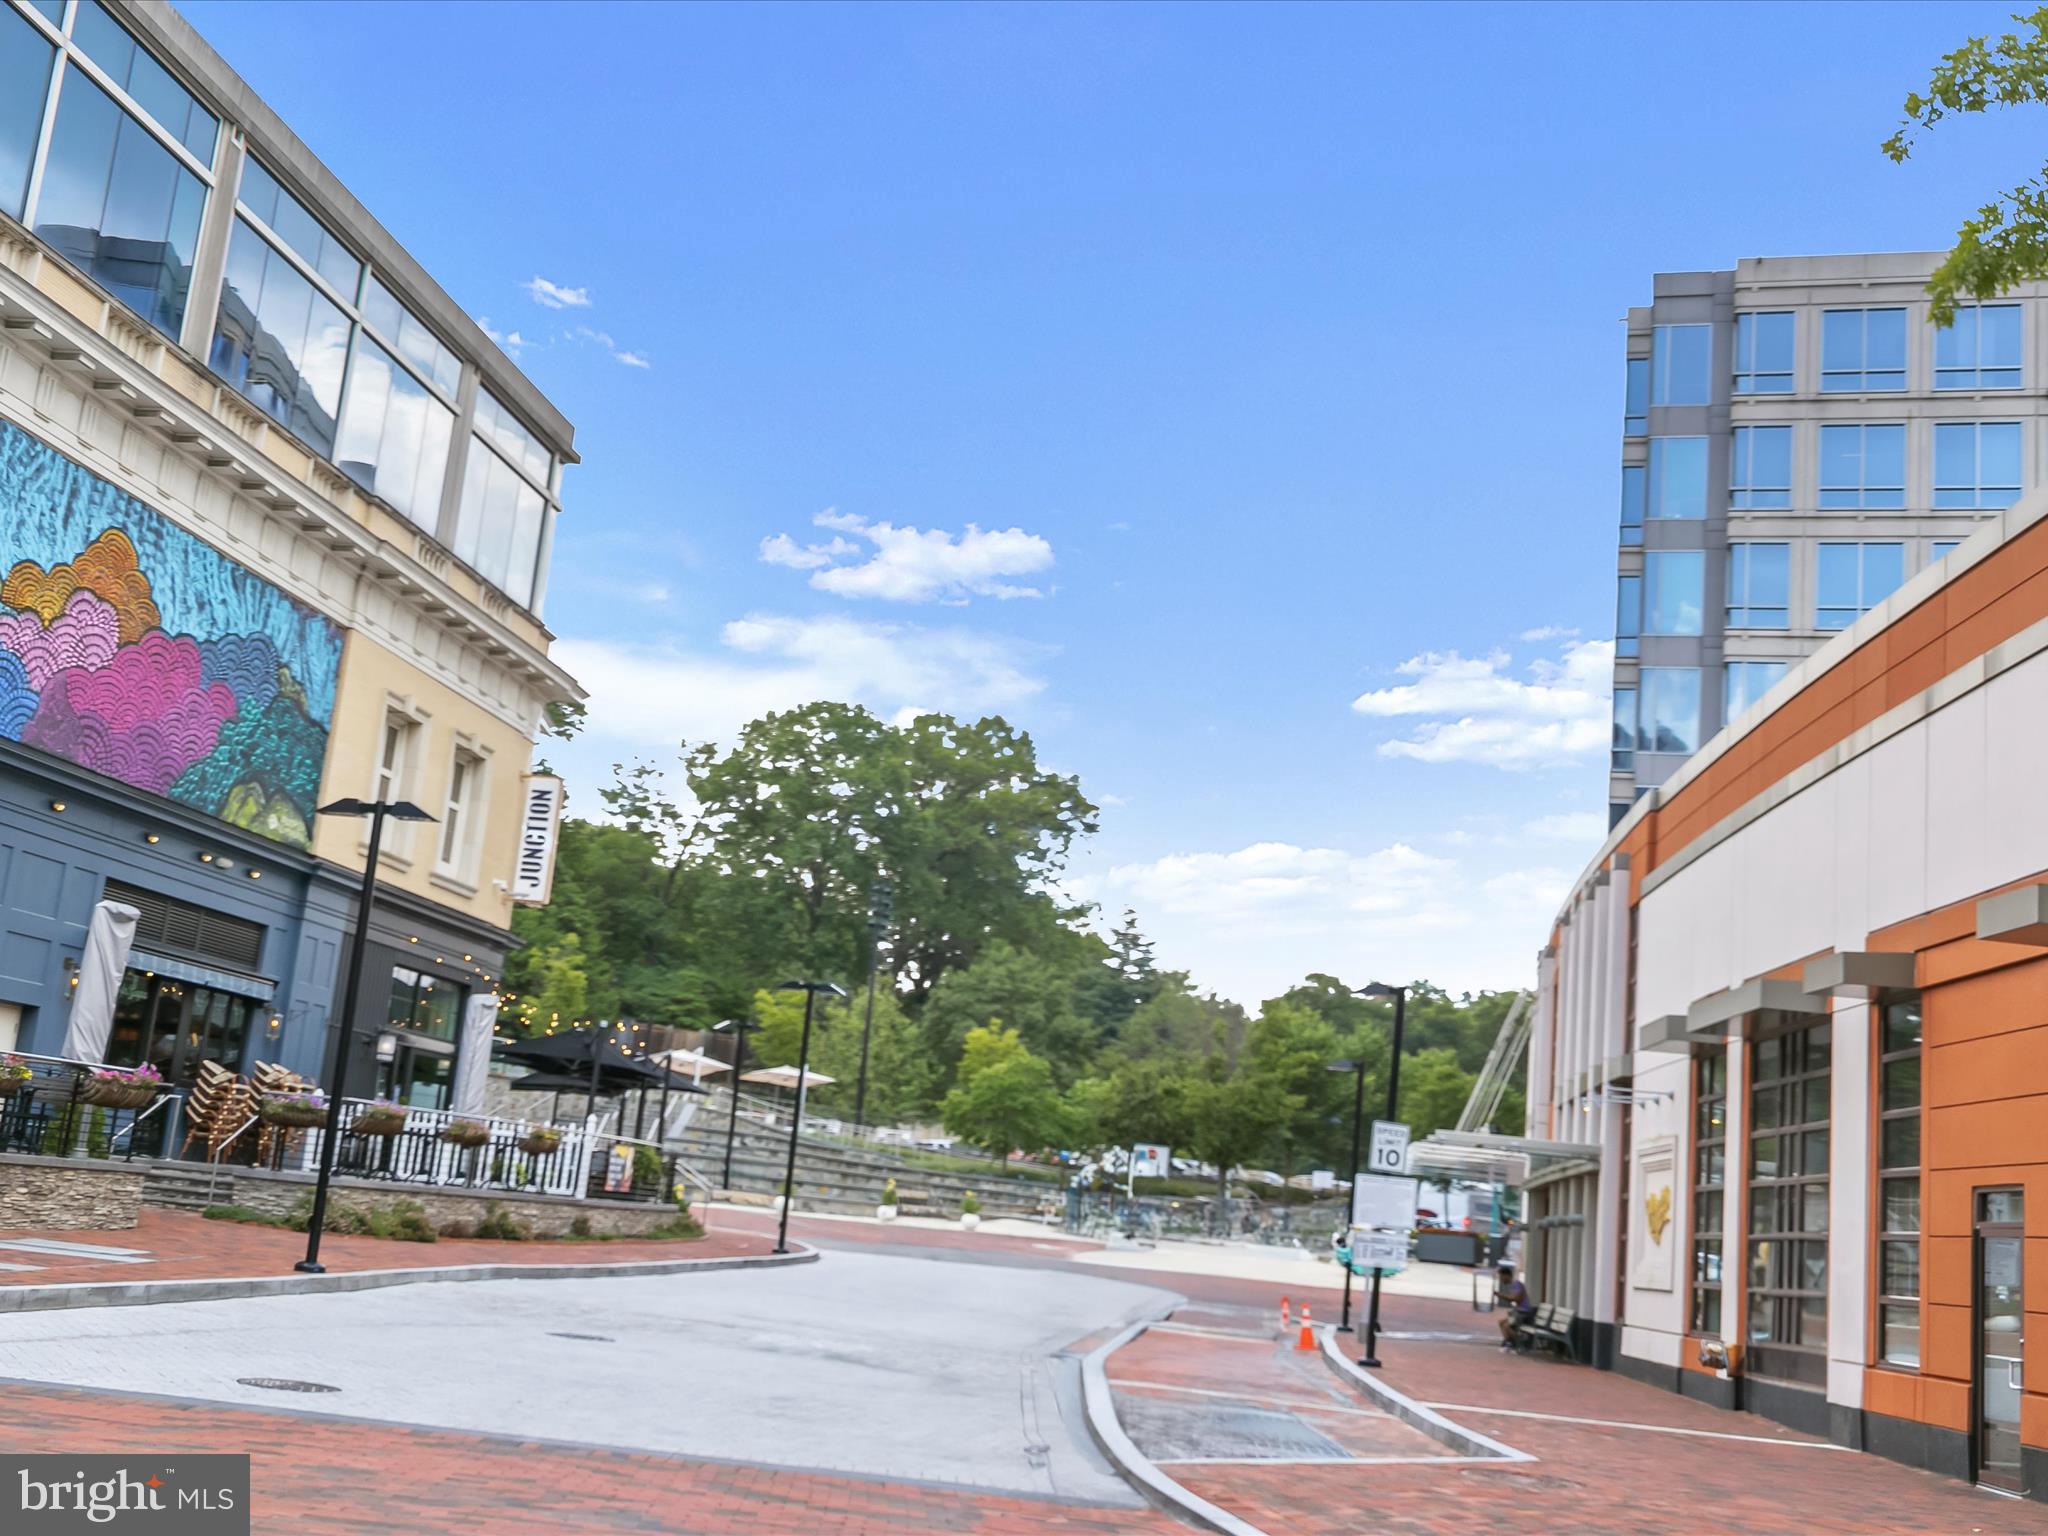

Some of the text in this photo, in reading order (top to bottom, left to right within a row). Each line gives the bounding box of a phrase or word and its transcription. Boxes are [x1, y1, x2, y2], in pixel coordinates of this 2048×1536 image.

[520, 789, 553, 888] JUNCTION
[1376, 1127, 1406, 1138] SPEED
[1378, 1148, 1400, 1166] 10
